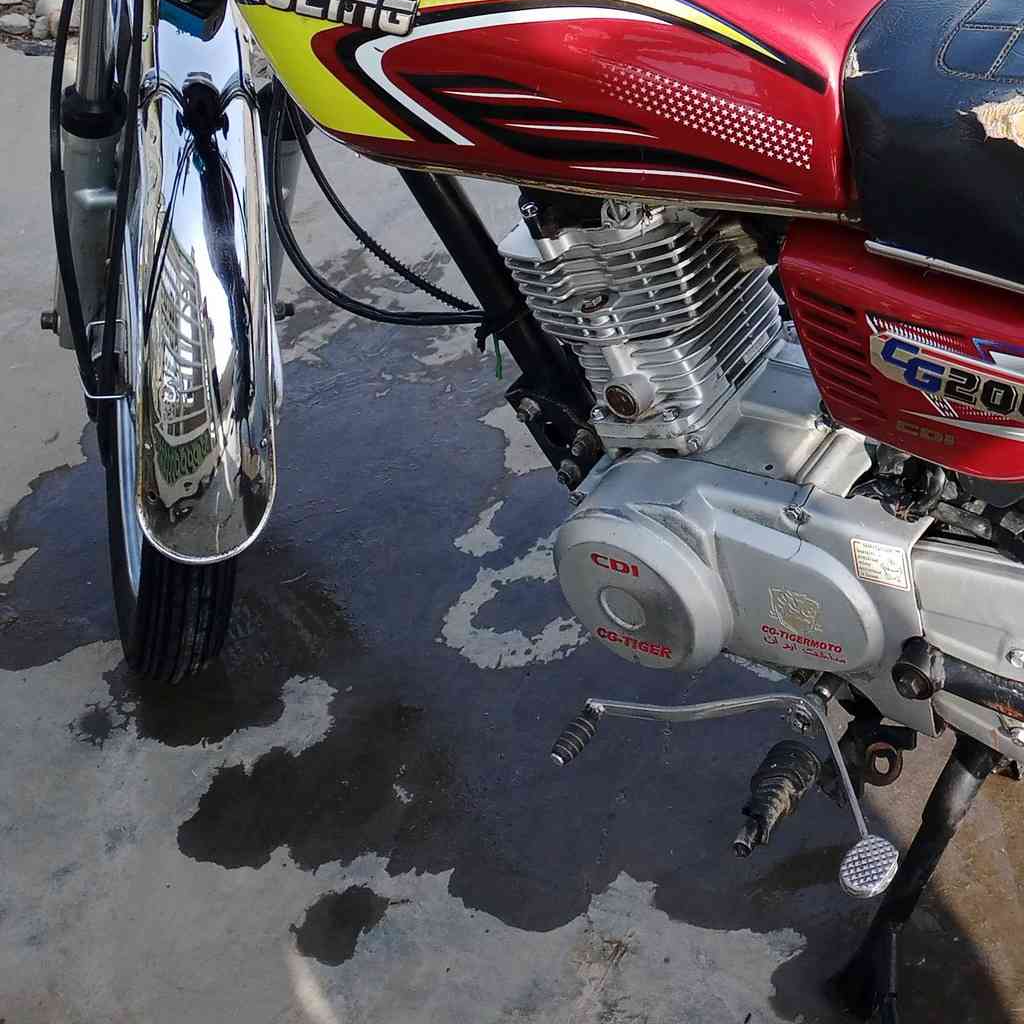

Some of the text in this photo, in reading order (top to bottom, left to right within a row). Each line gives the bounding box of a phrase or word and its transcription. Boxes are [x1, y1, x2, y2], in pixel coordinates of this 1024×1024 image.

[591, 552, 640, 577] CDI
[597, 626, 673, 660] CG-TIGER
[761, 624, 843, 654] CG-TIGERMOTO
